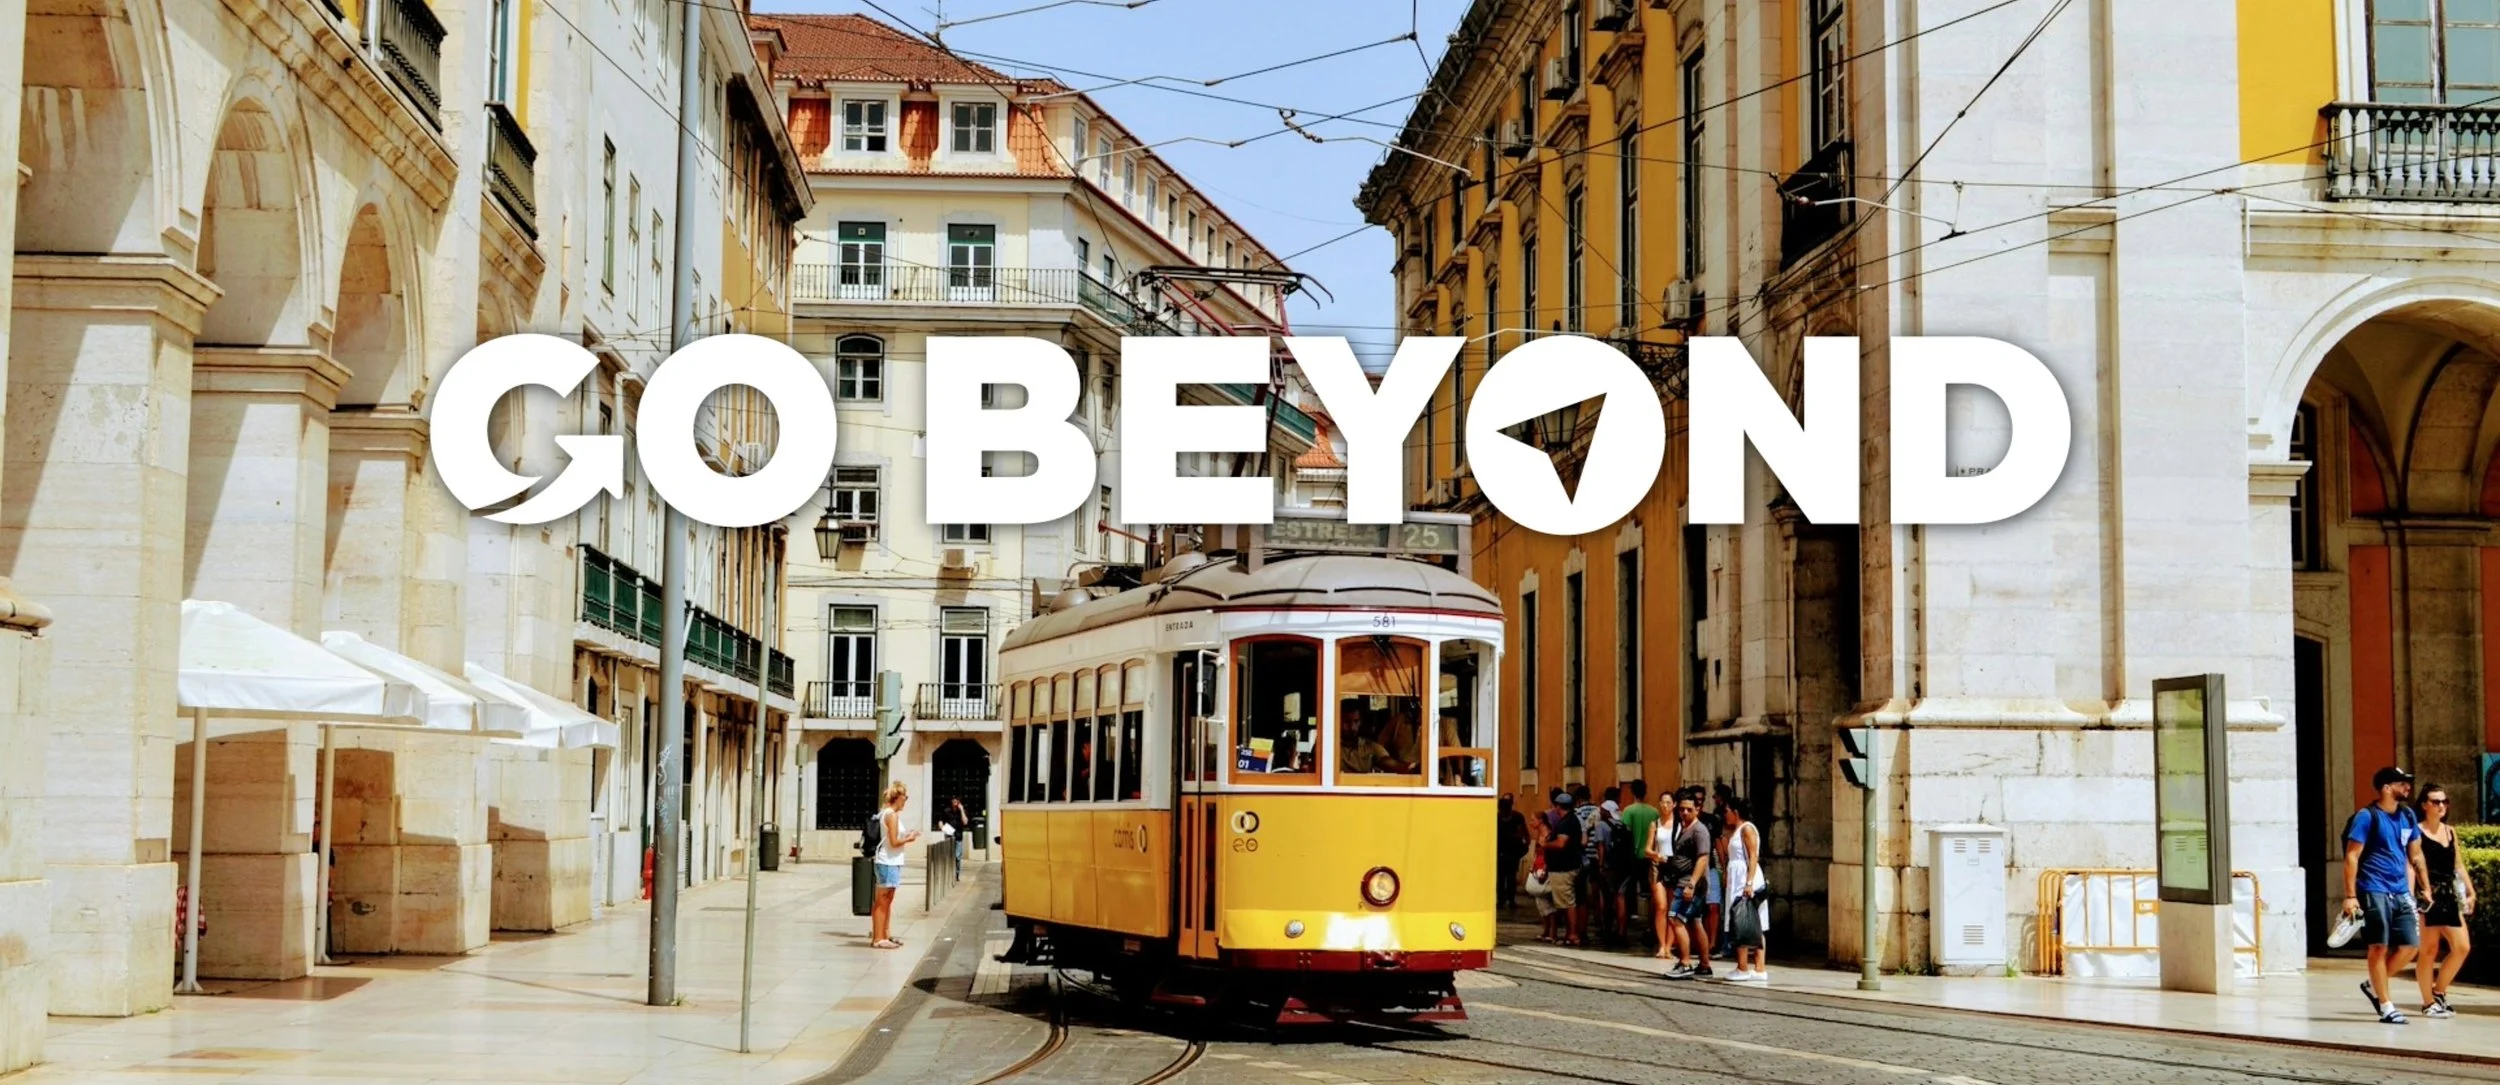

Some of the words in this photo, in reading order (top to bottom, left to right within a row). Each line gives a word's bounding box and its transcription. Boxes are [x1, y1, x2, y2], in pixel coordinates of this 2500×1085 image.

[1271, 520, 1381, 541] ESTRELA
[1403, 523, 1440, 548] 25
[1372, 615, 1396, 628] 581
[1237, 759, 1250, 769] 01
